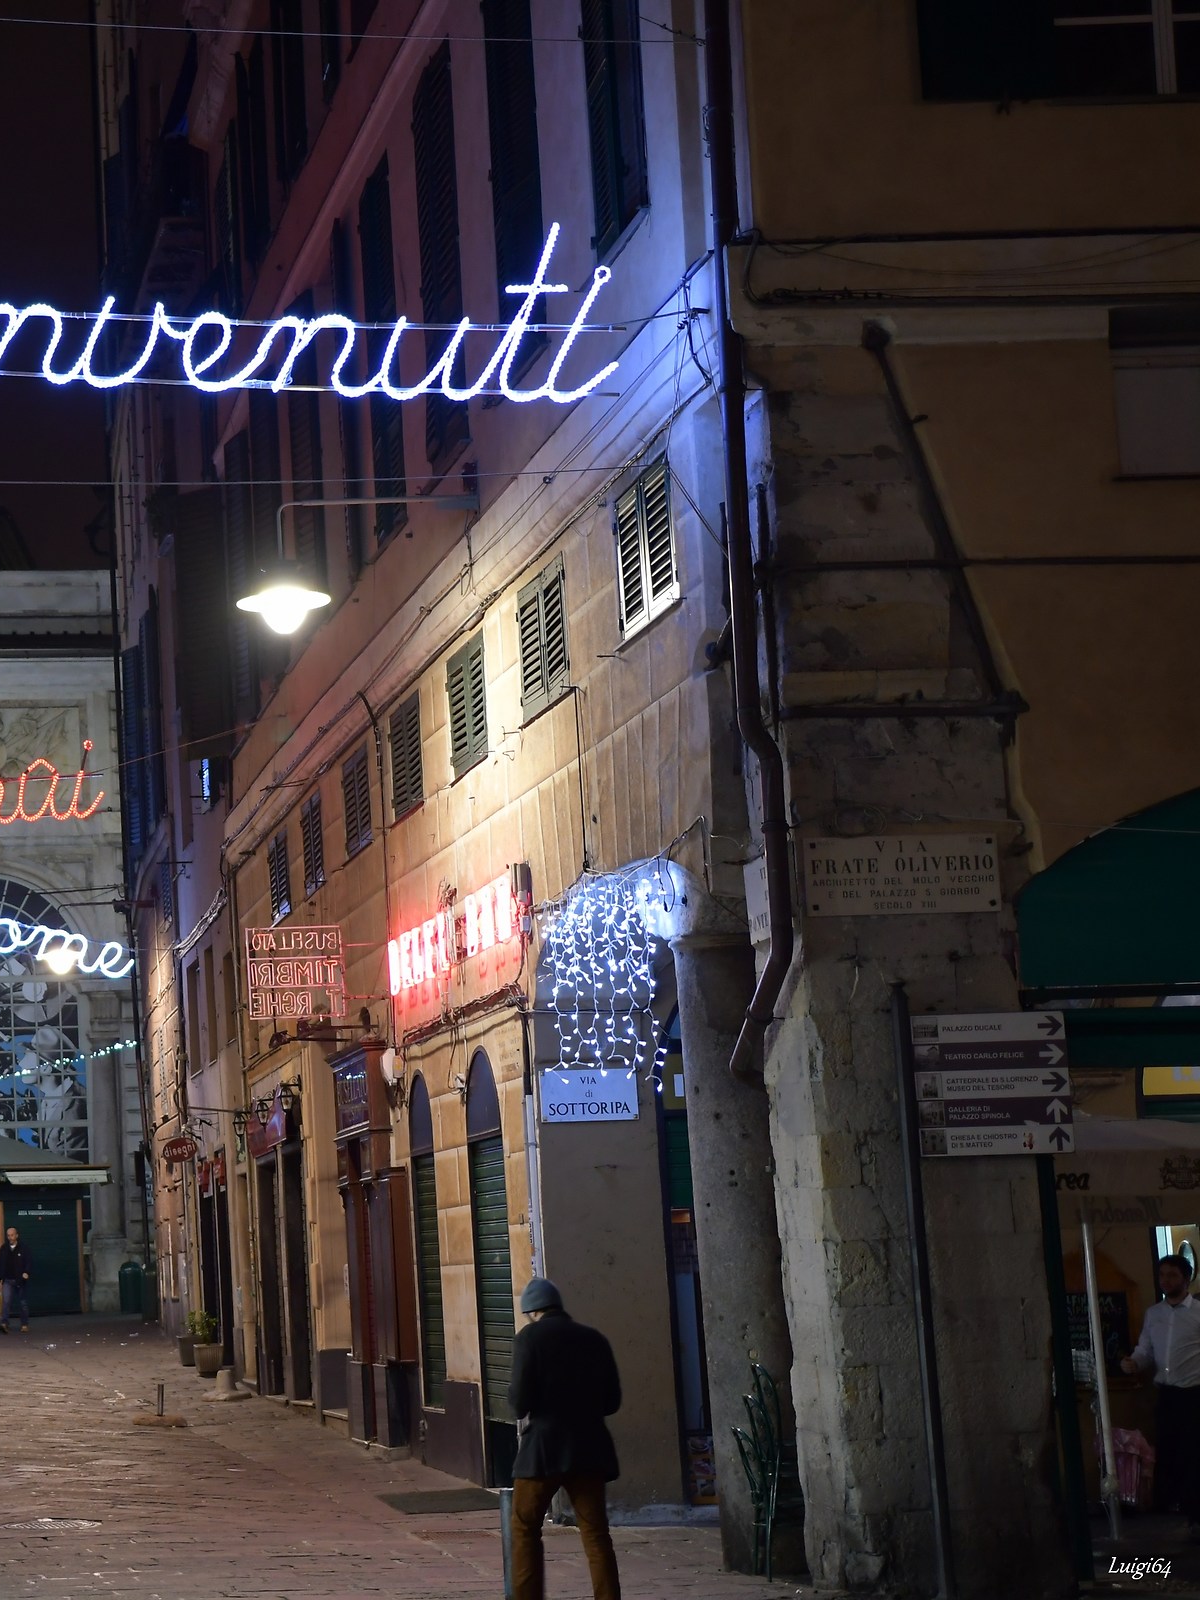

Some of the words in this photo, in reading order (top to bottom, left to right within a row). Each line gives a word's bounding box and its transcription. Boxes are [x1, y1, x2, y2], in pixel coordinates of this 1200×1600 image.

[874, 840, 927, 853] VIA
[811, 857, 879, 875] FRATE
[894, 854, 994, 872] OLIVERIO
[812, 877, 876, 887] ARCHITETTO
[884, 877, 903, 886] DEL
[913, 875, 941, 885] MOLO
[842, 890, 861, 899] DEL
[870, 889, 916, 898] PALAZZO
[940, 887, 981, 896] GIORGIO
[874, 901, 913, 910] SECOLO
[579, 1076, 597, 1085] VIA
[946, 1077, 989, 1085] CATTEDRALE
[585, 1090, 593, 1098] di
[548, 1102, 631, 1116] SOTTORIPA
[981, 1112, 1011, 1120] SPINOLA
